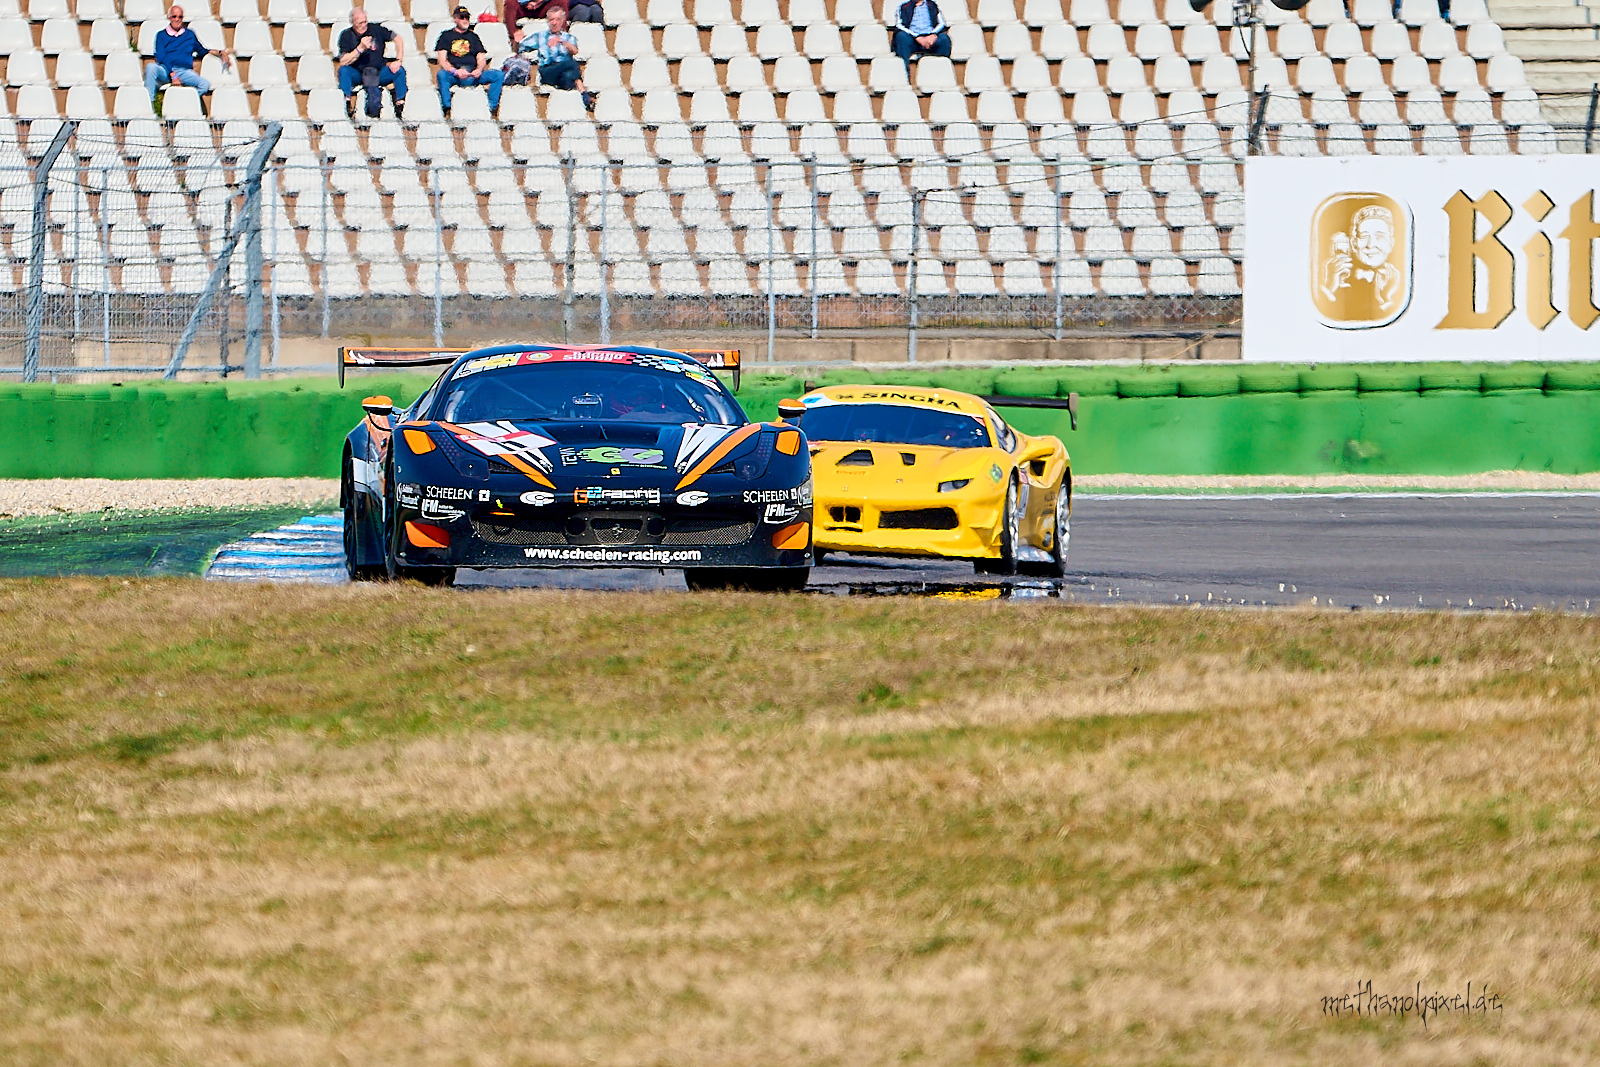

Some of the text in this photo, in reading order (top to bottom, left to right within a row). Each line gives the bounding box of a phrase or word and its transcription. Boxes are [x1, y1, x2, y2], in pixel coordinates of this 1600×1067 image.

[861, 392, 962, 410] SINGHA
[426, 485, 473, 500] SCHEELEN
[743, 489, 789, 504] SCHEELEN
[523, 547, 702, 564] www.scheelen-racing.com
